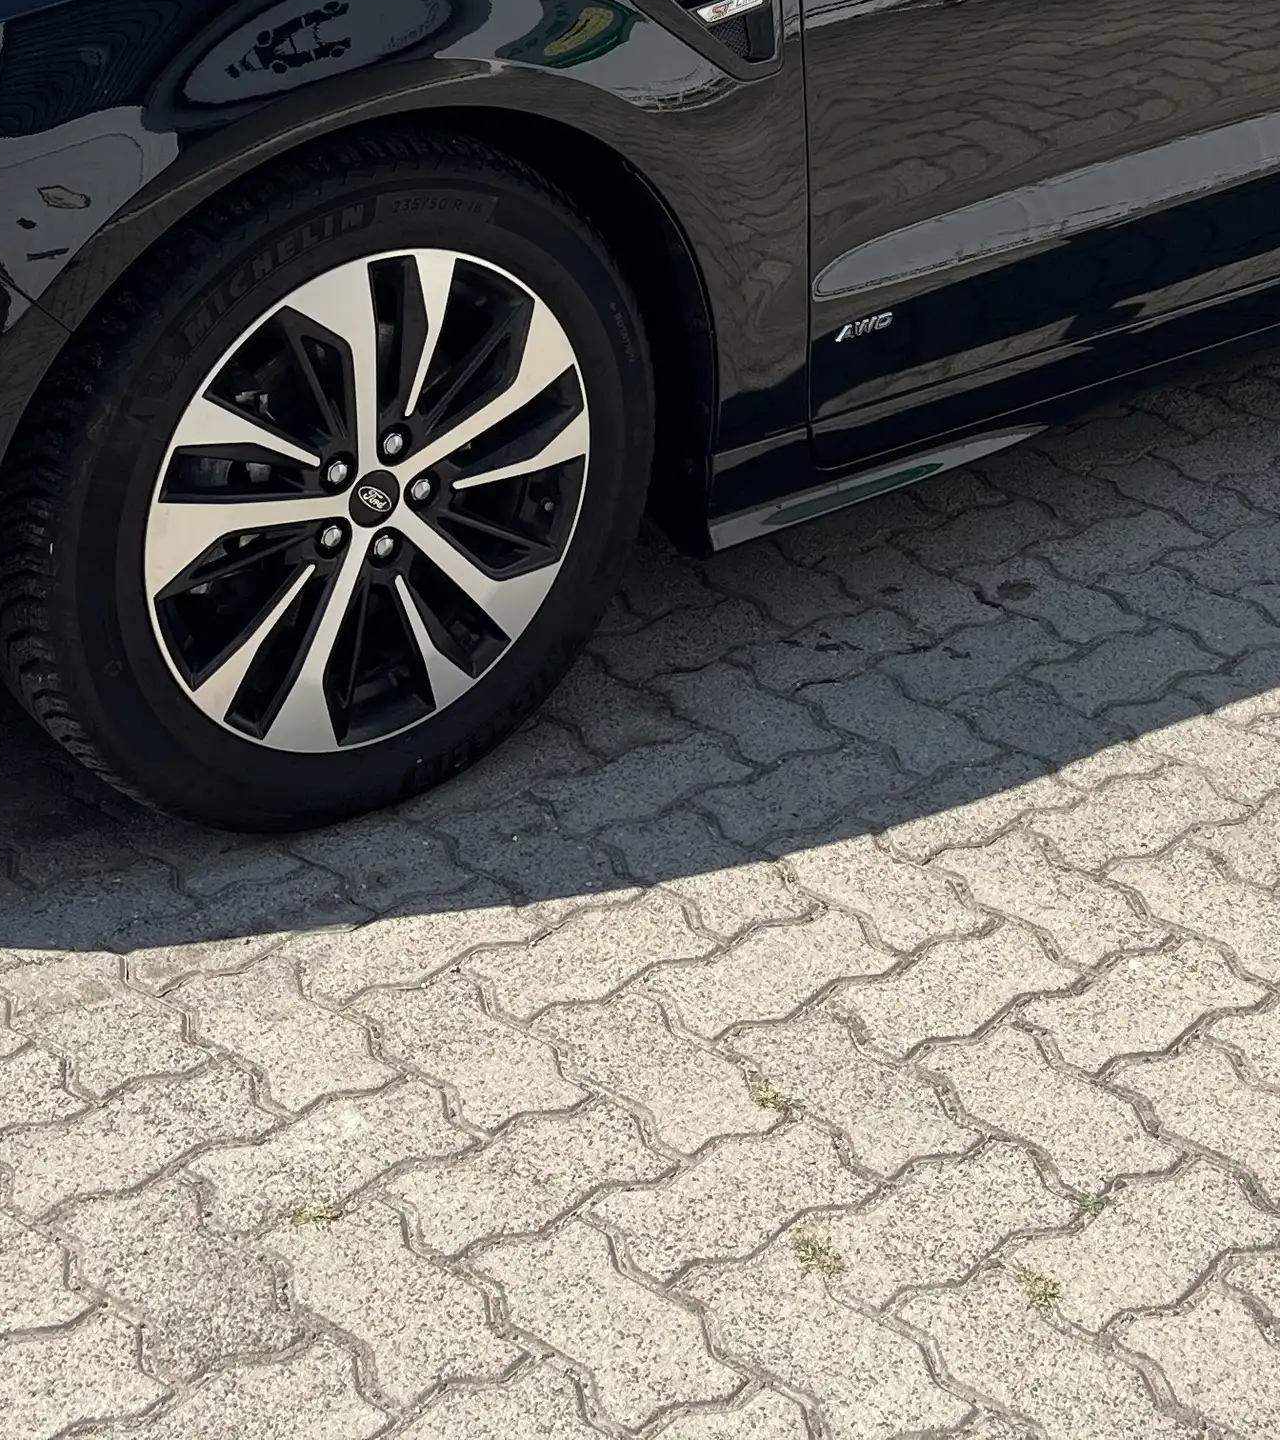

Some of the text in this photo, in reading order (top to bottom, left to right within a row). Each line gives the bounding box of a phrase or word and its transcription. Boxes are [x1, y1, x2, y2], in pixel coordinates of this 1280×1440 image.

[184, 204, 365, 349] MICHELIN
[392, 196, 449, 213] 235/50
[452, 198, 464, 211] R
[835, 311, 893, 342] AWD
[362, 489, 388, 509] Ford
